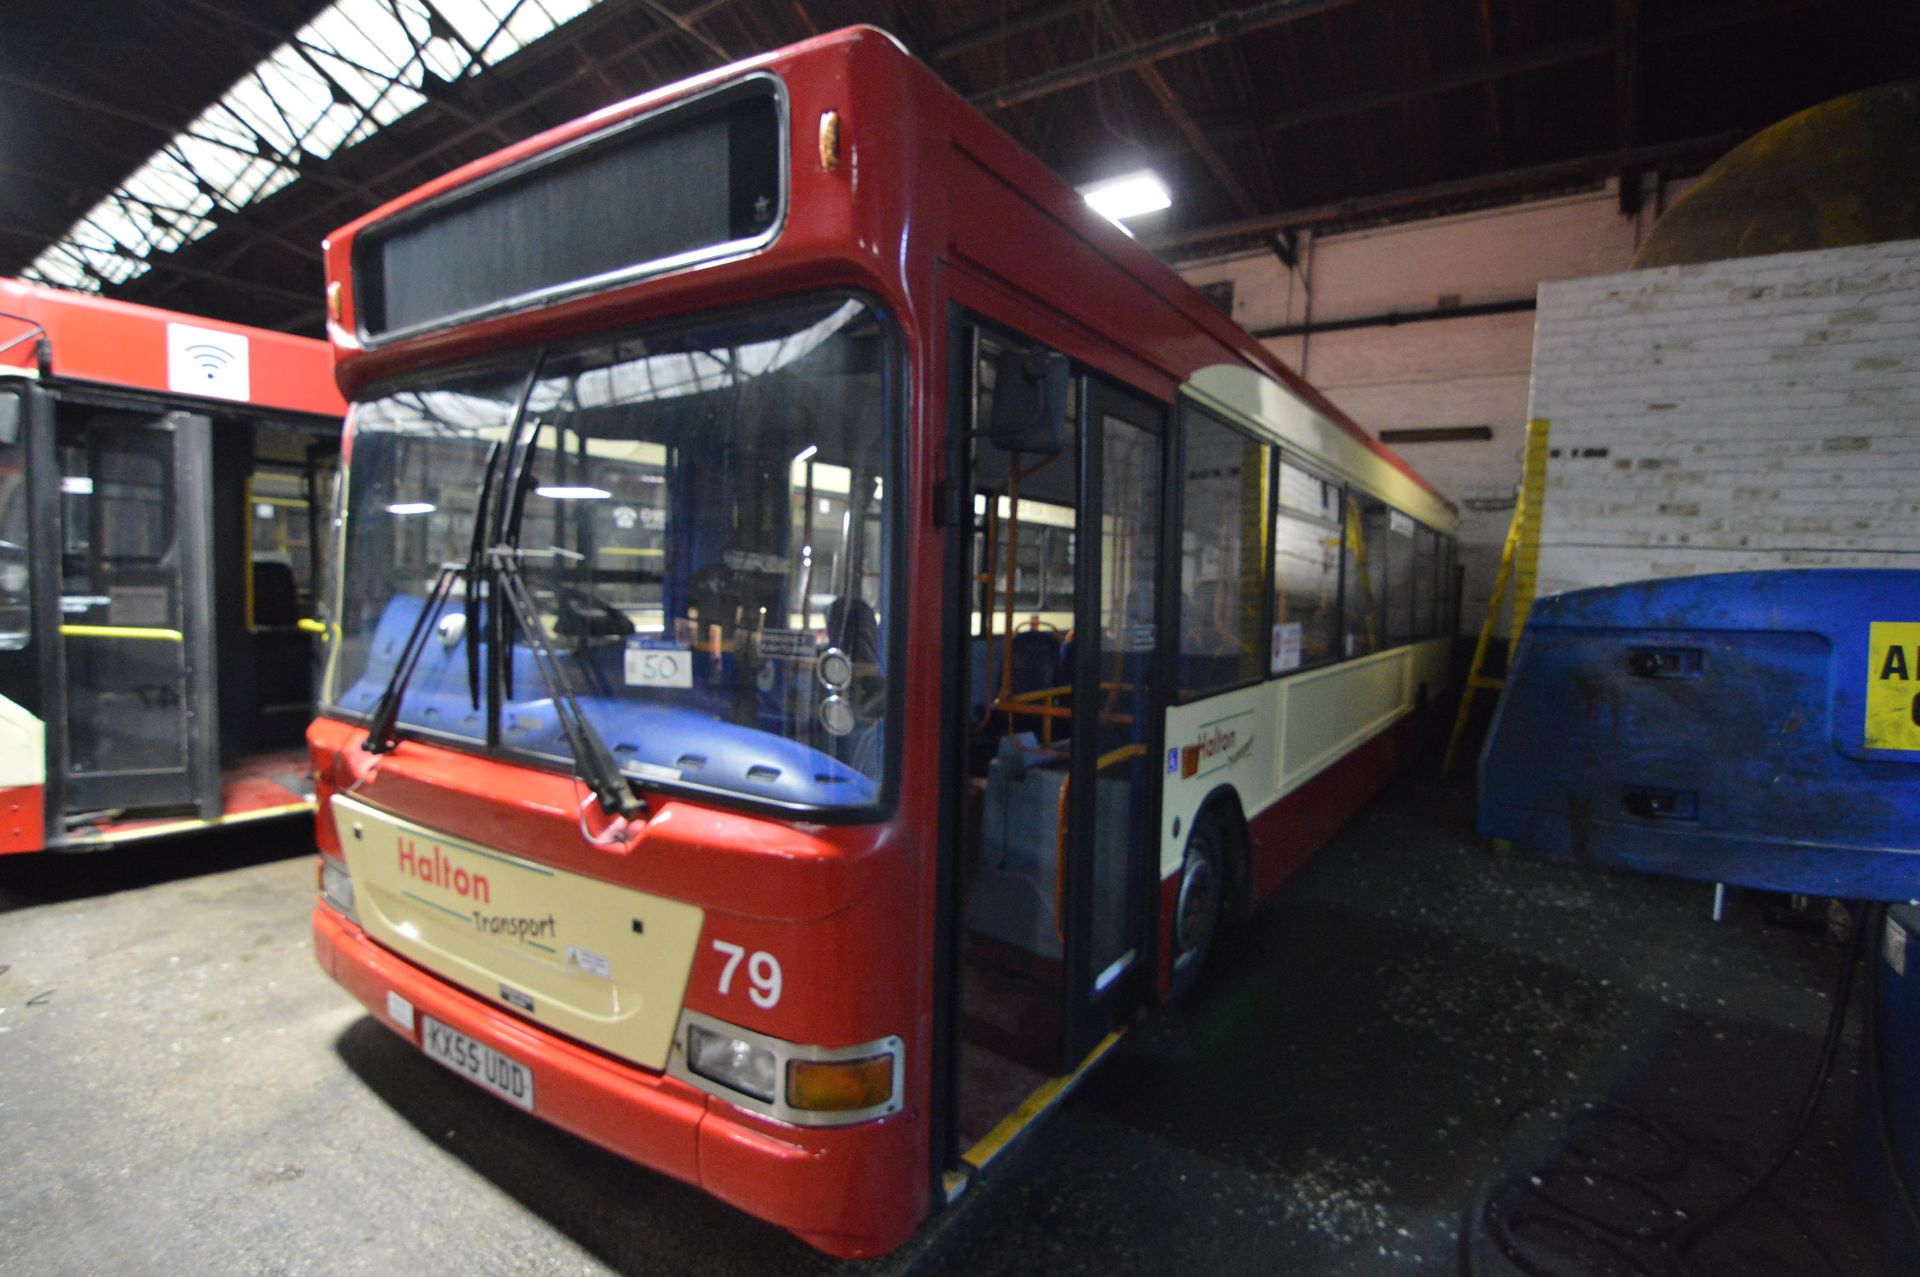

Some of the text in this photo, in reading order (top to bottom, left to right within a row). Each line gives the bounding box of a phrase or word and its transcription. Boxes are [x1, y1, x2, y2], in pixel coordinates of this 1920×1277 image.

[642, 653, 679, 680] 50
[397, 836, 490, 903] Halton
[472, 910, 557, 943] Transport
[712, 939, 783, 1010] 79
